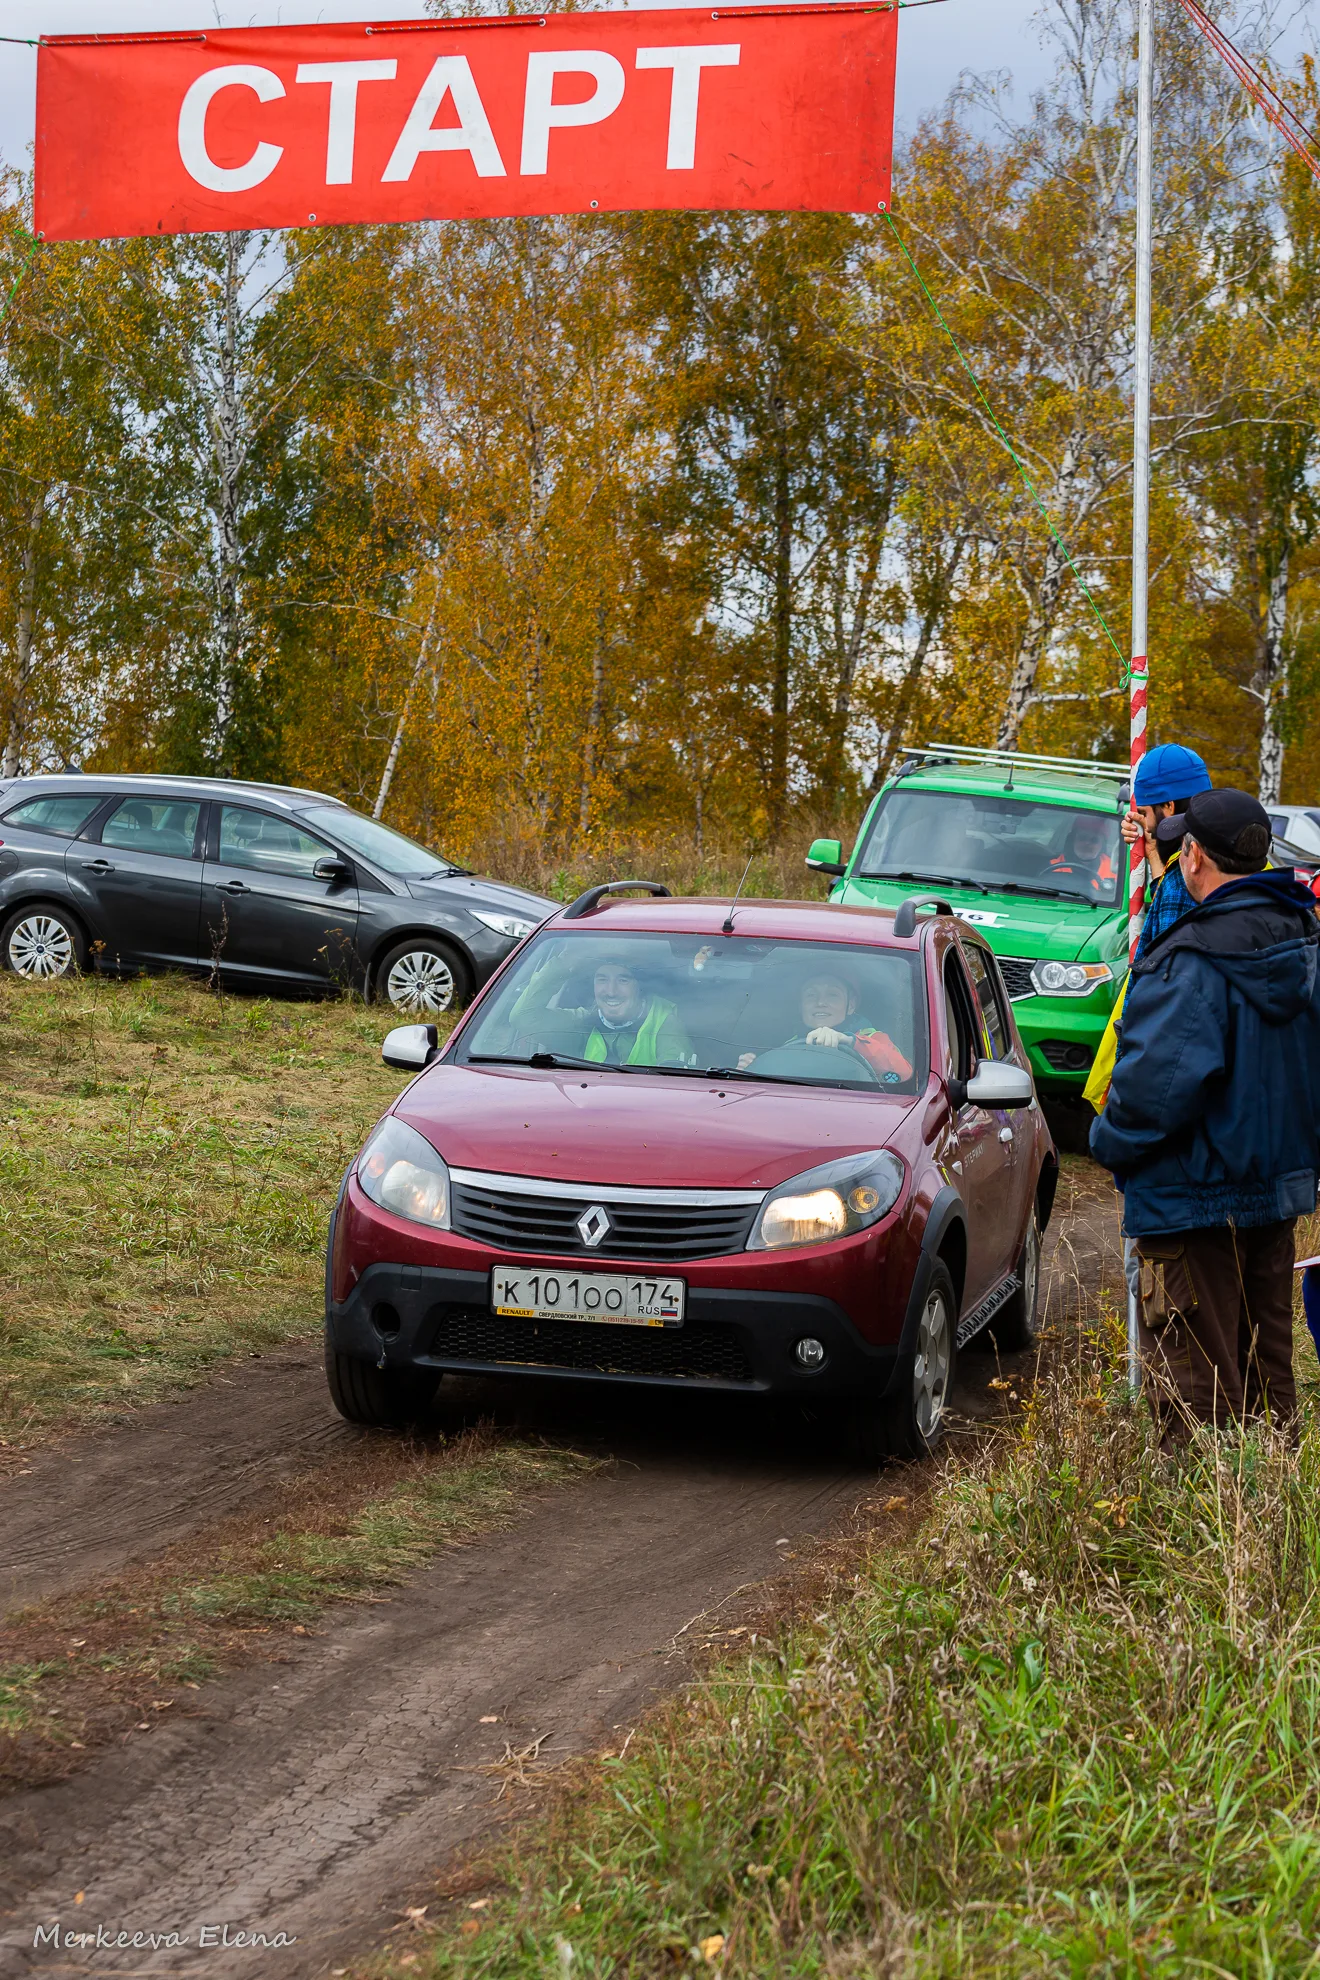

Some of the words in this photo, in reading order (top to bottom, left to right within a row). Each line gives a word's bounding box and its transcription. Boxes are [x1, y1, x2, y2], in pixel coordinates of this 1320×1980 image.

[177, 43, 741, 194] СТАРТ
[630, 1282, 675, 1307] 174
[501, 1308, 531, 1316] RENAULT
[637, 1305, 660, 1316] RUS
